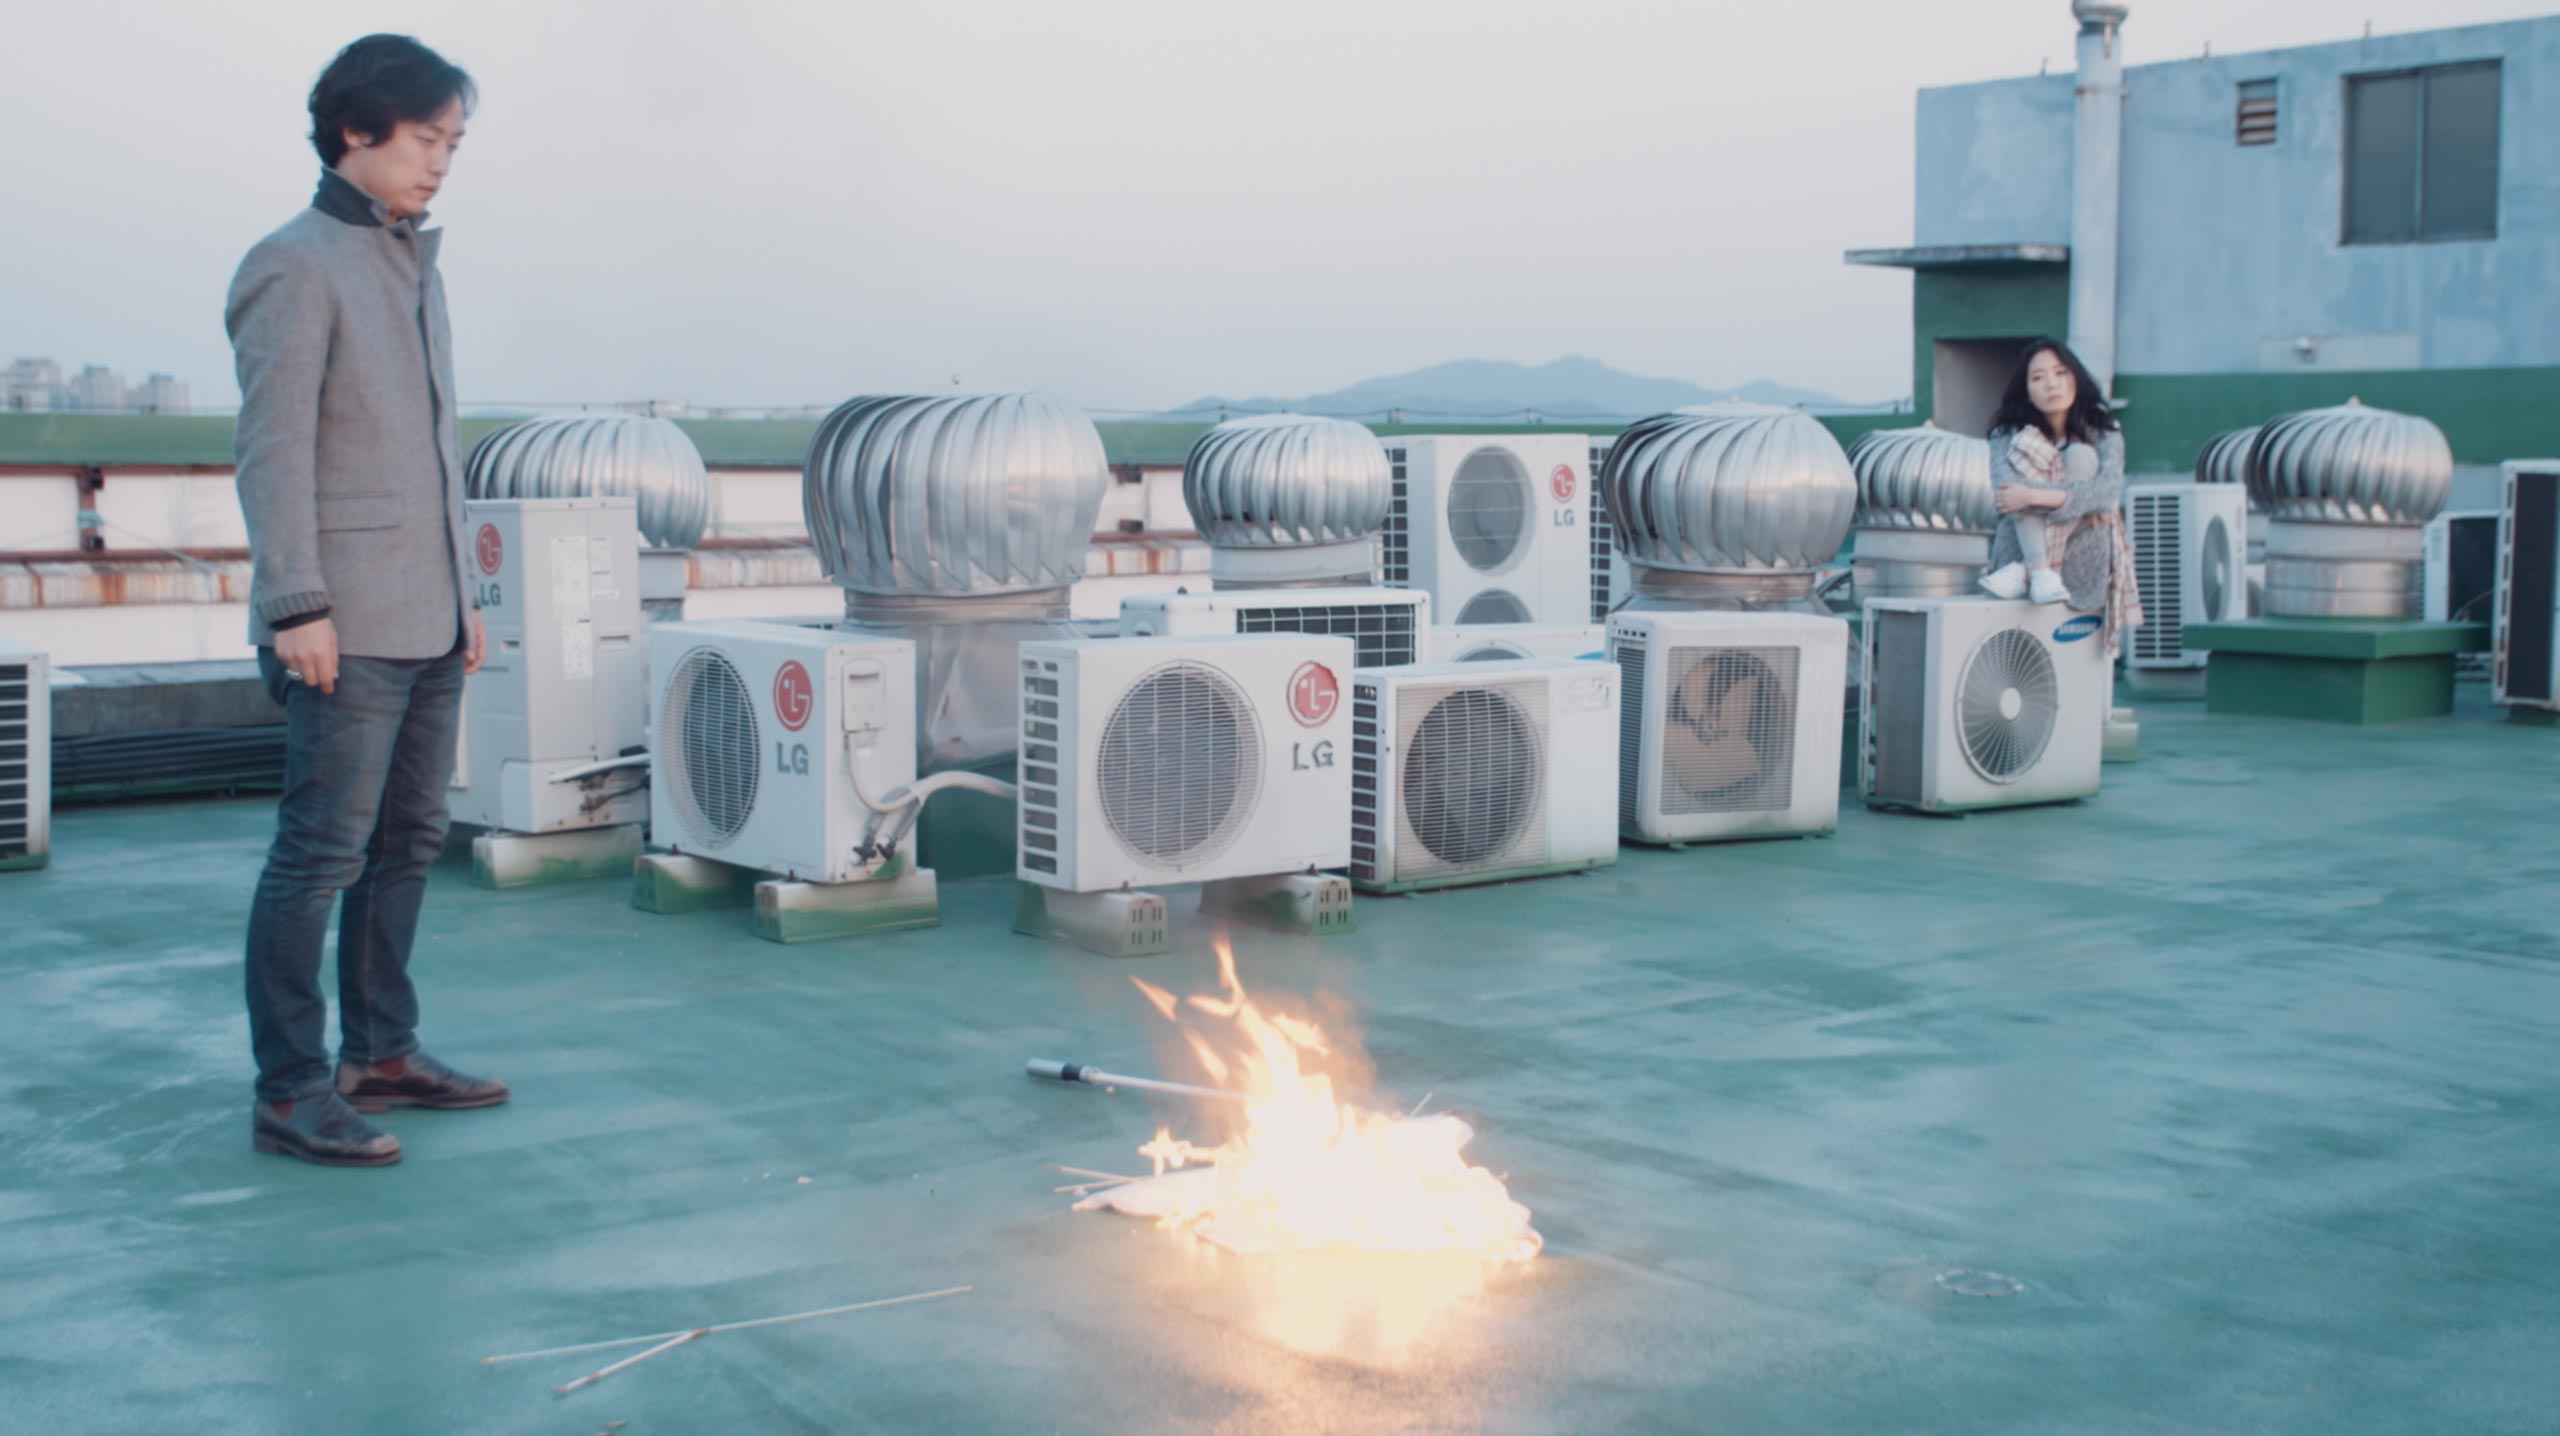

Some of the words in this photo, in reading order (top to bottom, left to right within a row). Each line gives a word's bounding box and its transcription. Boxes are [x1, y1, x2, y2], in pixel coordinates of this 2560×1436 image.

[1553, 509, 1575, 528] LG
[480, 583, 502, 606] LG
[776, 741, 809, 776] LG
[1293, 740, 1334, 771] LG
